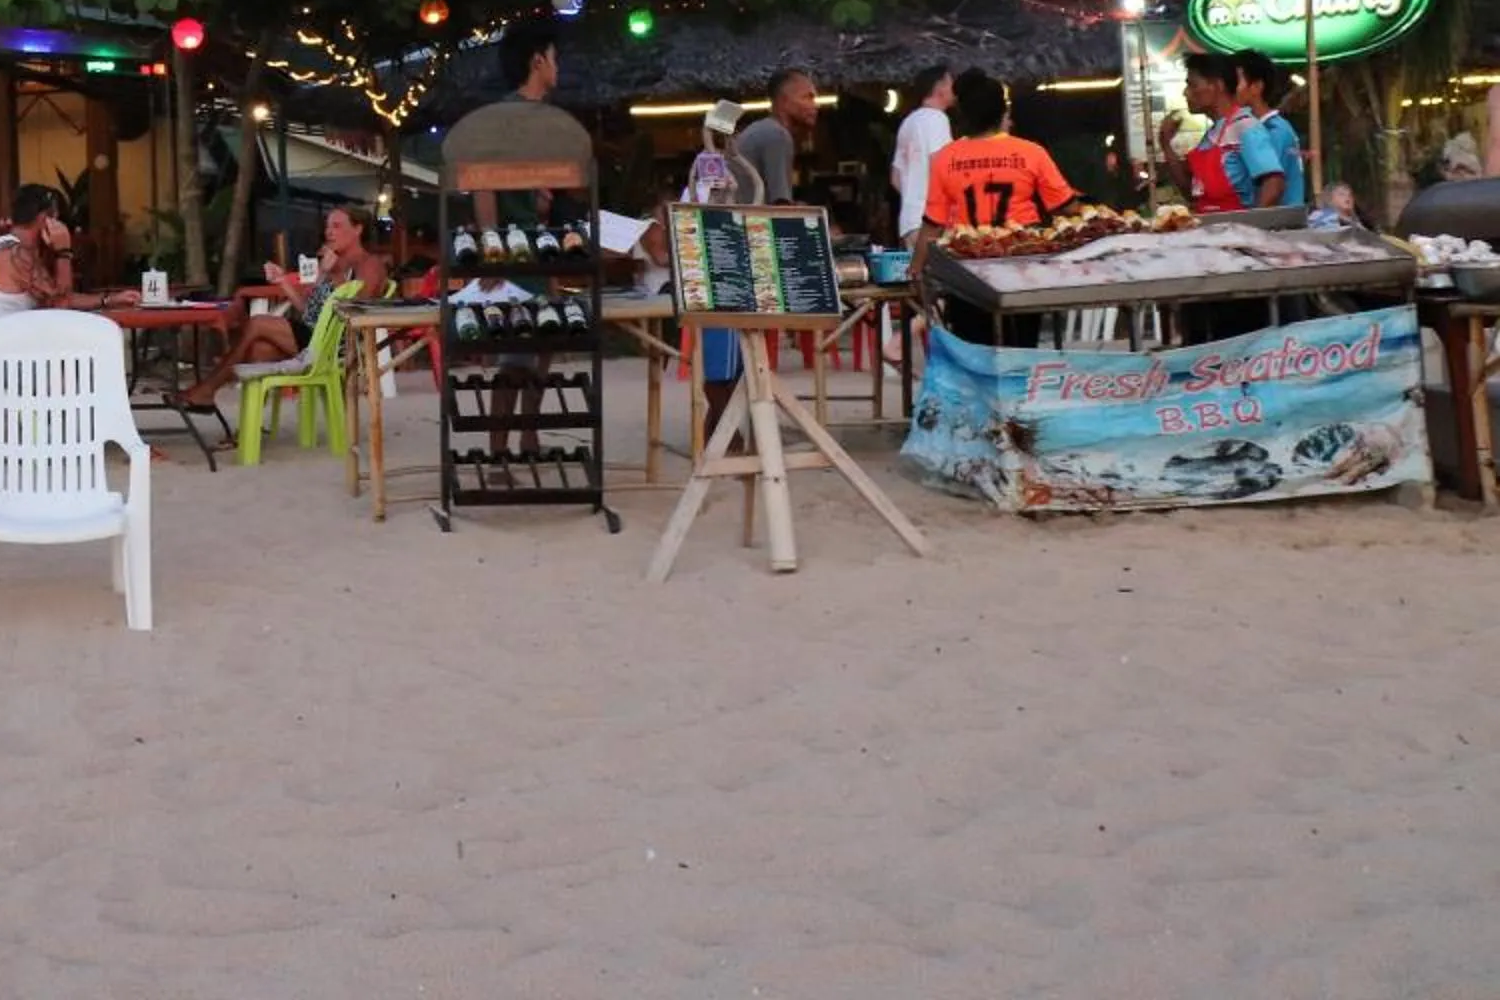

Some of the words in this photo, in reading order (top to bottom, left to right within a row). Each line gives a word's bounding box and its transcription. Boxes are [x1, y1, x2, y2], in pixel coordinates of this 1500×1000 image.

[963, 181, 1015, 229] 17
[147, 279, 159, 297] 4
[1026, 358, 1169, 401] Fresh
[1184, 322, 1381, 393] Seafood
